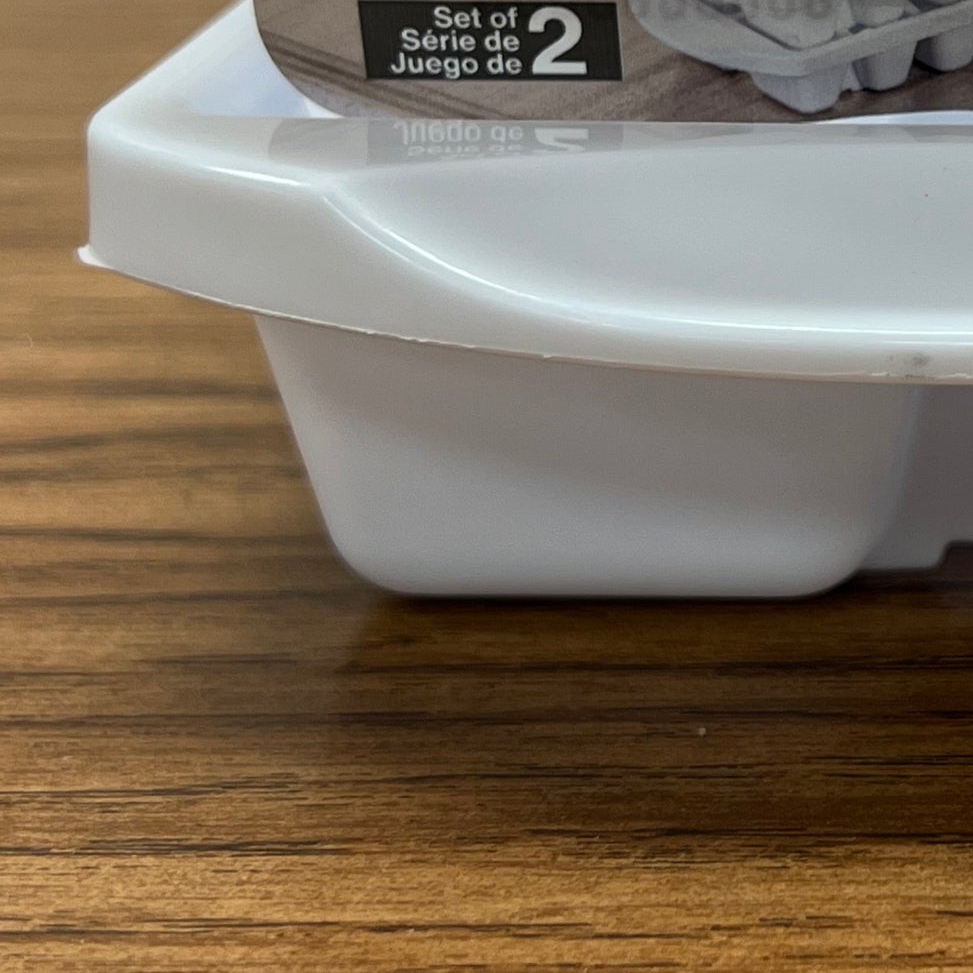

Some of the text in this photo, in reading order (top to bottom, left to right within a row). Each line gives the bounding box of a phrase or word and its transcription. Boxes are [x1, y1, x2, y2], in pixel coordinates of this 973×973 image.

[433, 5, 519, 29] Set of
[401, 29, 520, 52] Série de
[528, 6, 588, 75] 2
[391, 52, 523, 79] Juego de
